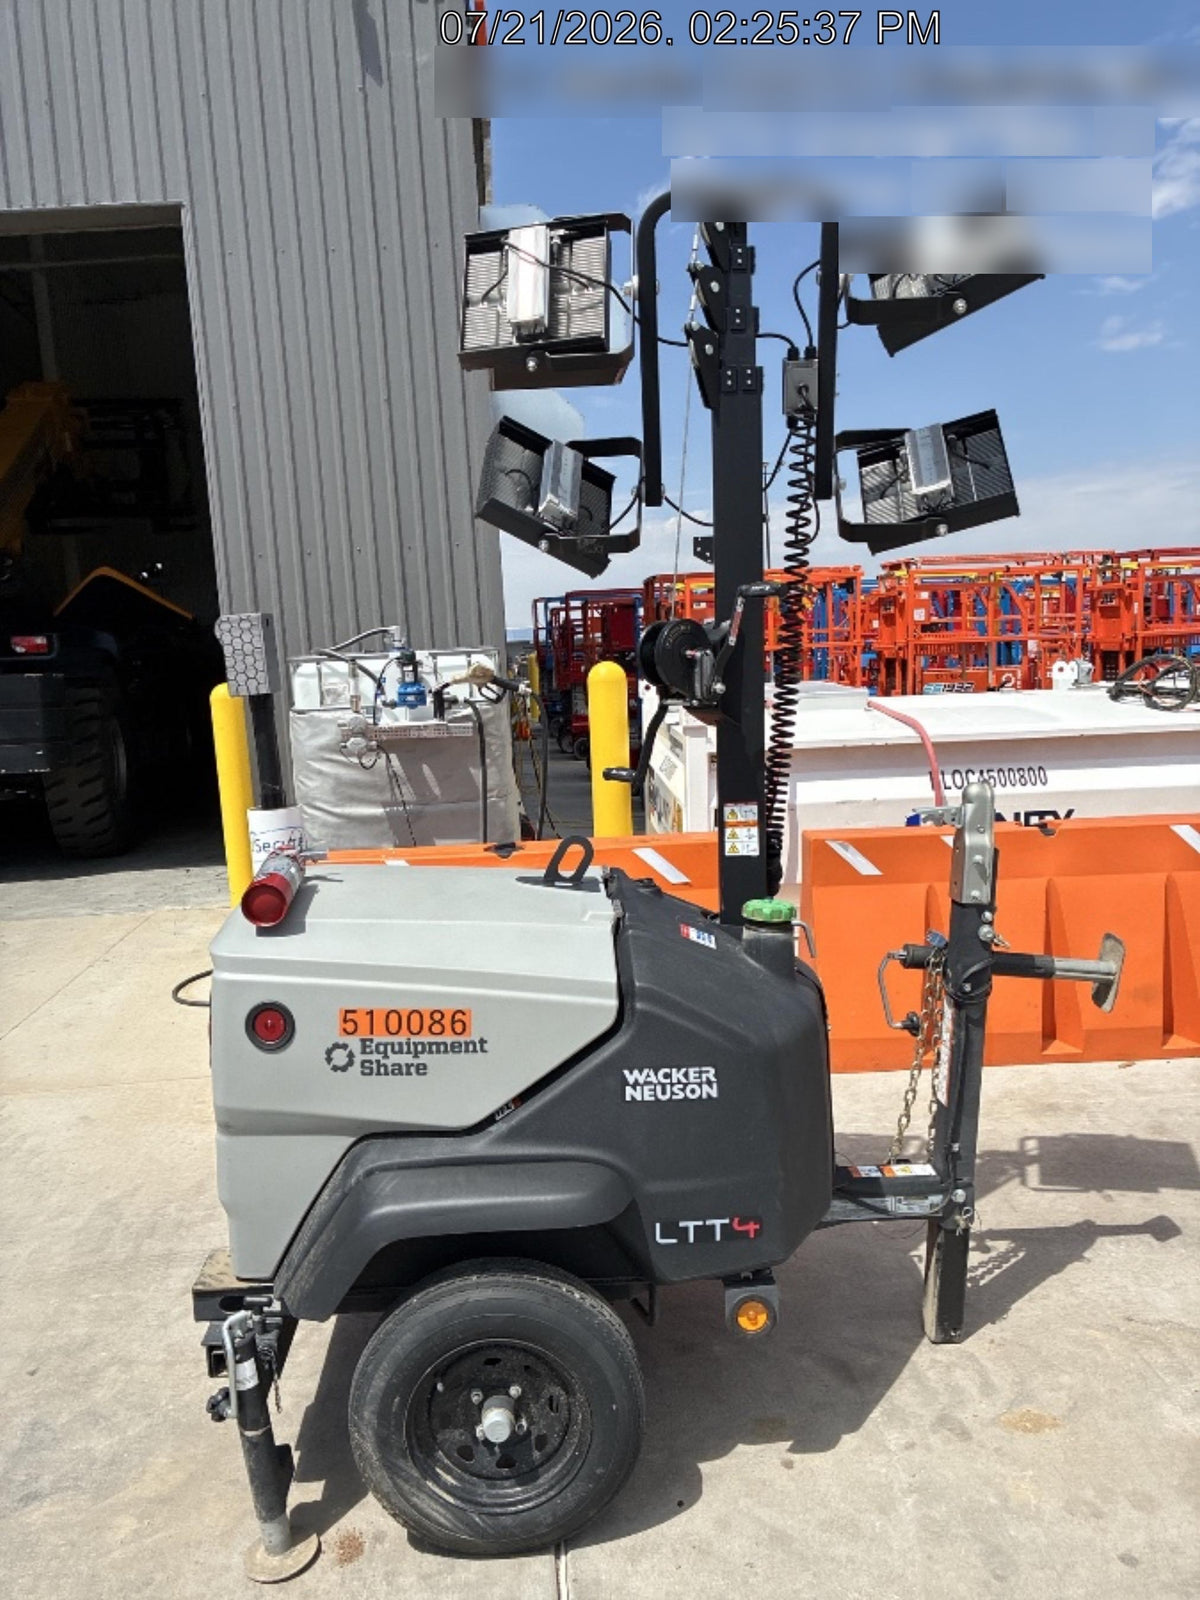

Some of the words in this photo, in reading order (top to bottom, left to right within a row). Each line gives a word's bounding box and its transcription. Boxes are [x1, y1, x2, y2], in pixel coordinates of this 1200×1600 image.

[342, 1009, 467, 1036] 510086
[359, 1037, 488, 1059] Equipment
[360, 1059, 428, 1076] Share
[622, 1066, 718, 1085] WACKER
[625, 1083, 719, 1101] NEUSON
[655, 1216, 760, 1244] LTT4
